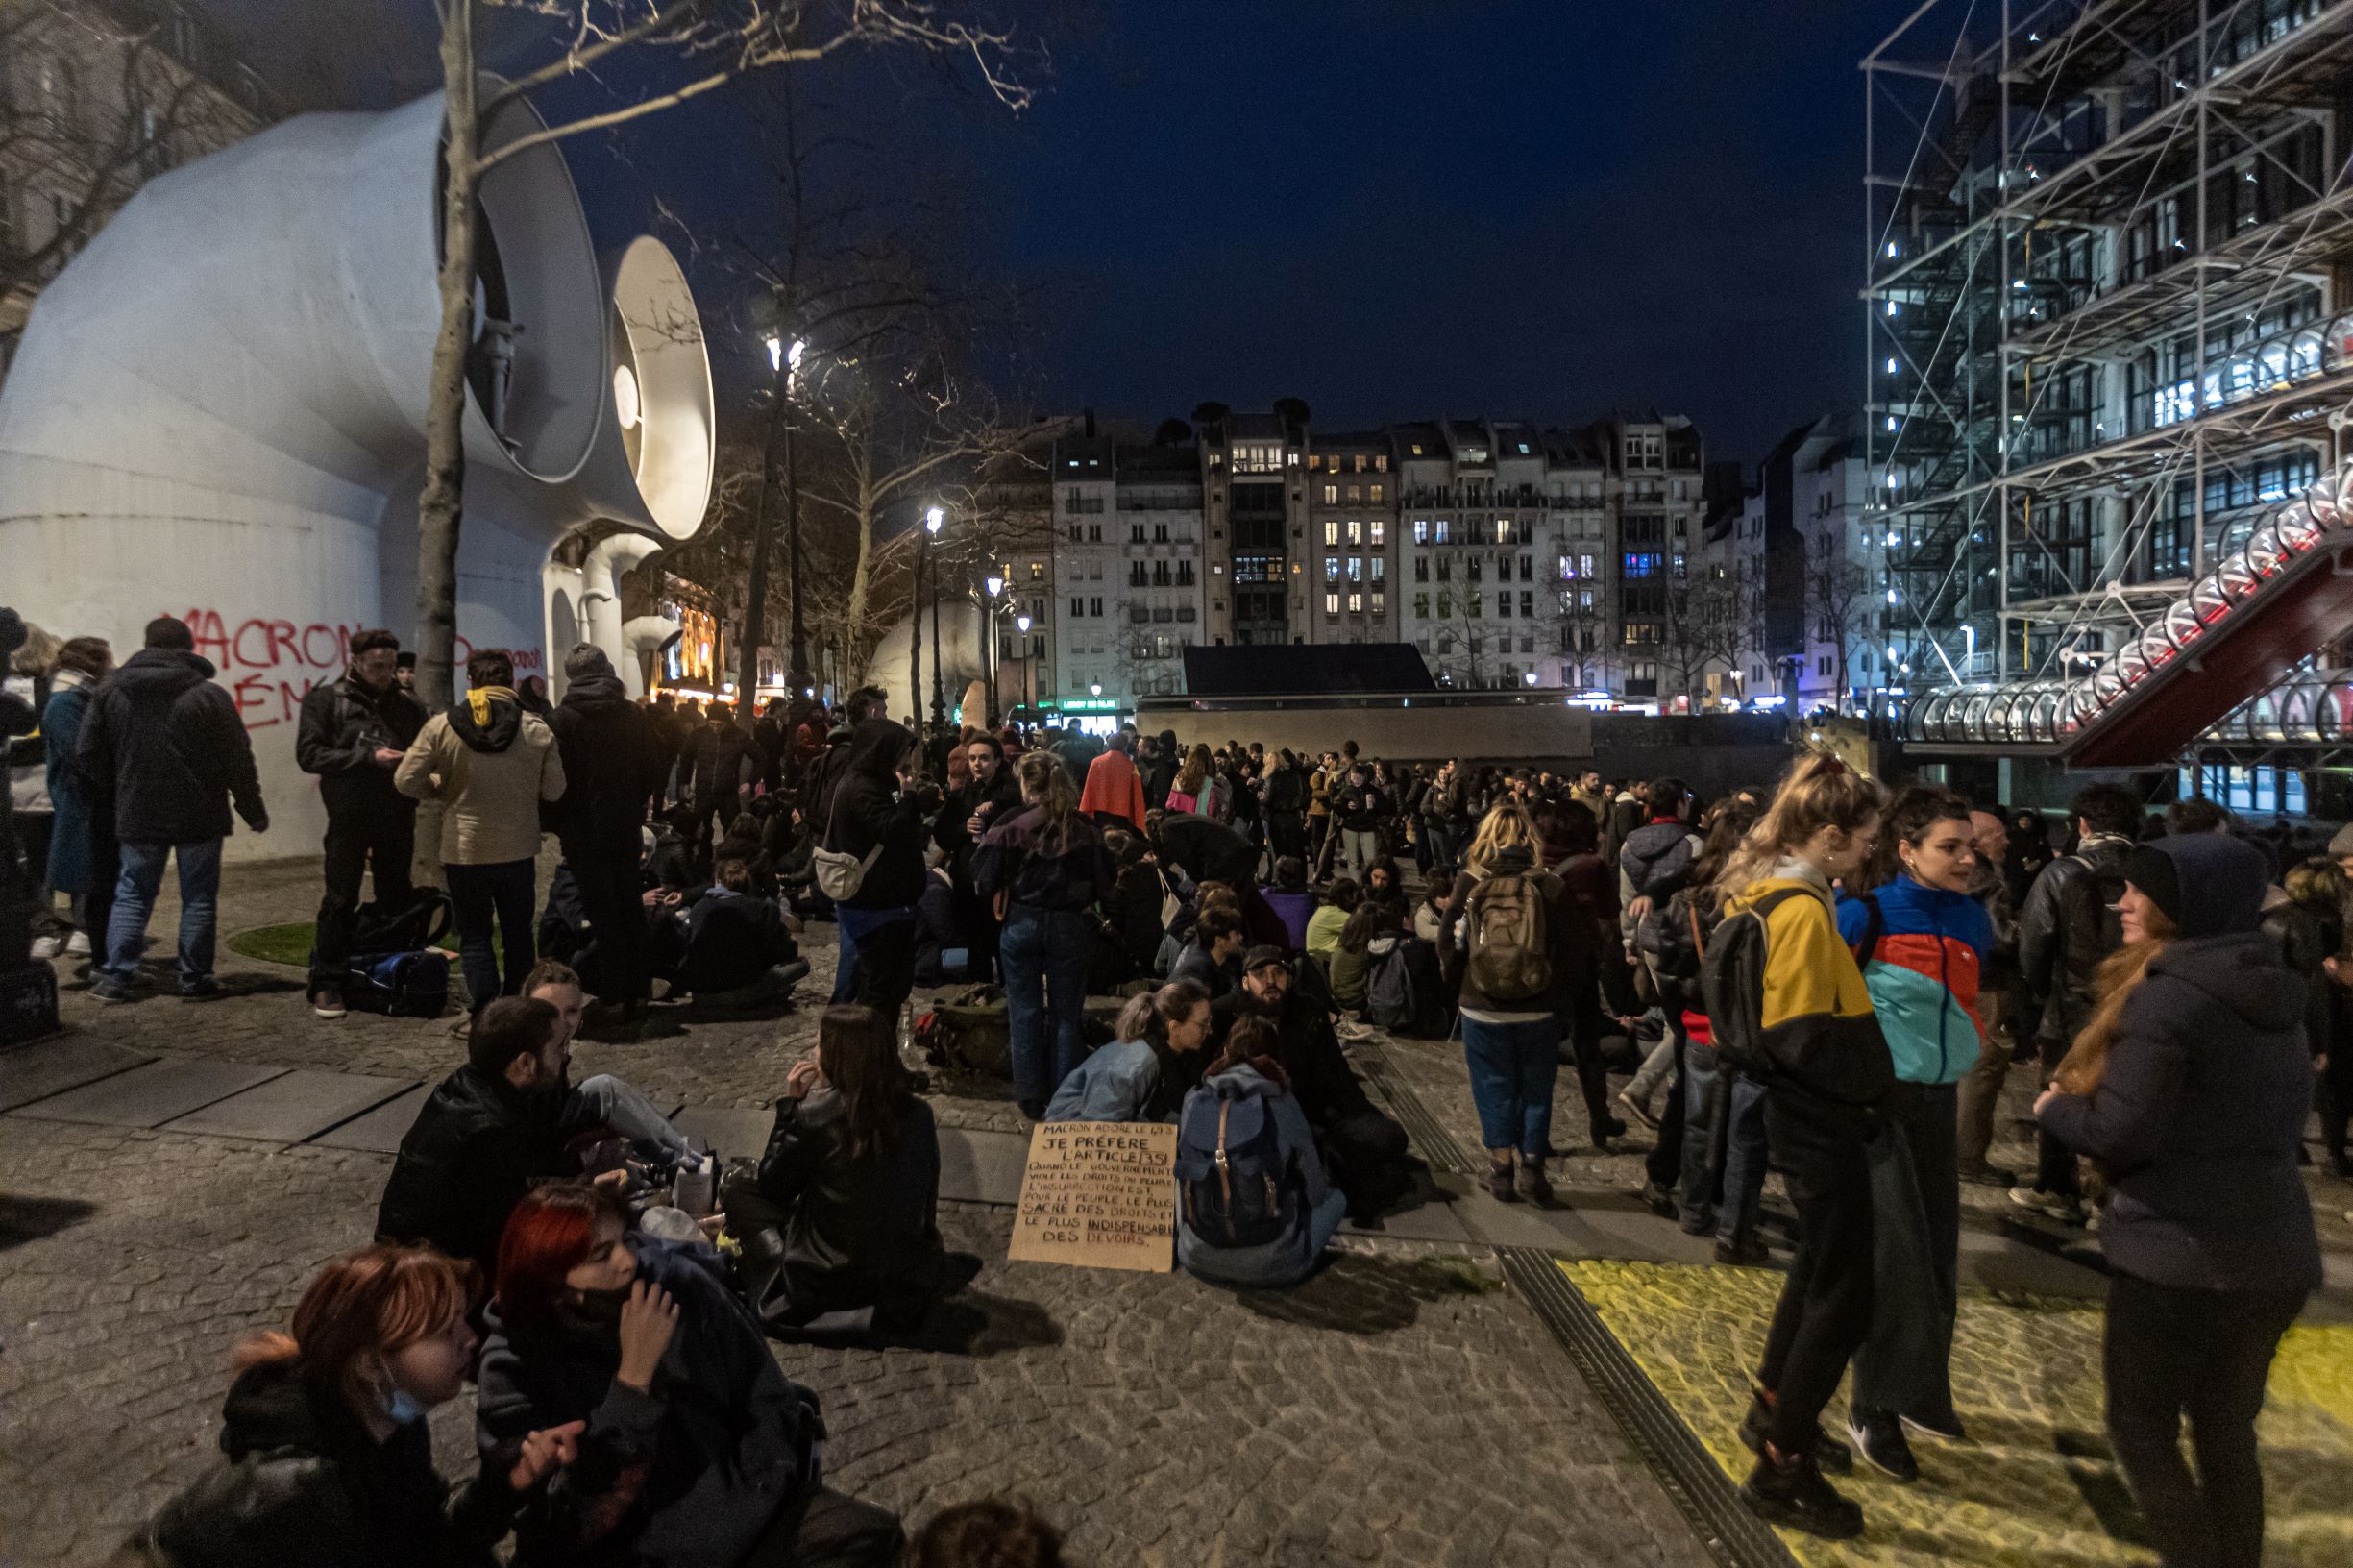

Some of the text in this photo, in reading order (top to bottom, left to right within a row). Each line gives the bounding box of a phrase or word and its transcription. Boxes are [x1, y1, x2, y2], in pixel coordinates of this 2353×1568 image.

[1044, 1124, 1091, 1134] MACRON
[1042, 1138, 1067, 1149] JE
[1063, 1149, 1137, 1163] L'ARTICLE
[1091, 1163, 1170, 1176] GOUVERNEMENT
[1083, 1173, 1120, 1183] DROITS
[1025, 1191, 1050, 1201] POUR
[1057, 1192, 1069, 1201] LE
[1127, 1196, 1140, 1207] LE
[1146, 1198, 1173, 1207] PLUS
[1076, 1204, 1104, 1214] DES
[1111, 1207, 1156, 1218] DROITS
[1161, 1212, 1172, 1220] ET
[1025, 1216, 1172, 1235] LE PLUS INDISPENSABLE
[1042, 1230, 1079, 1242] DES
